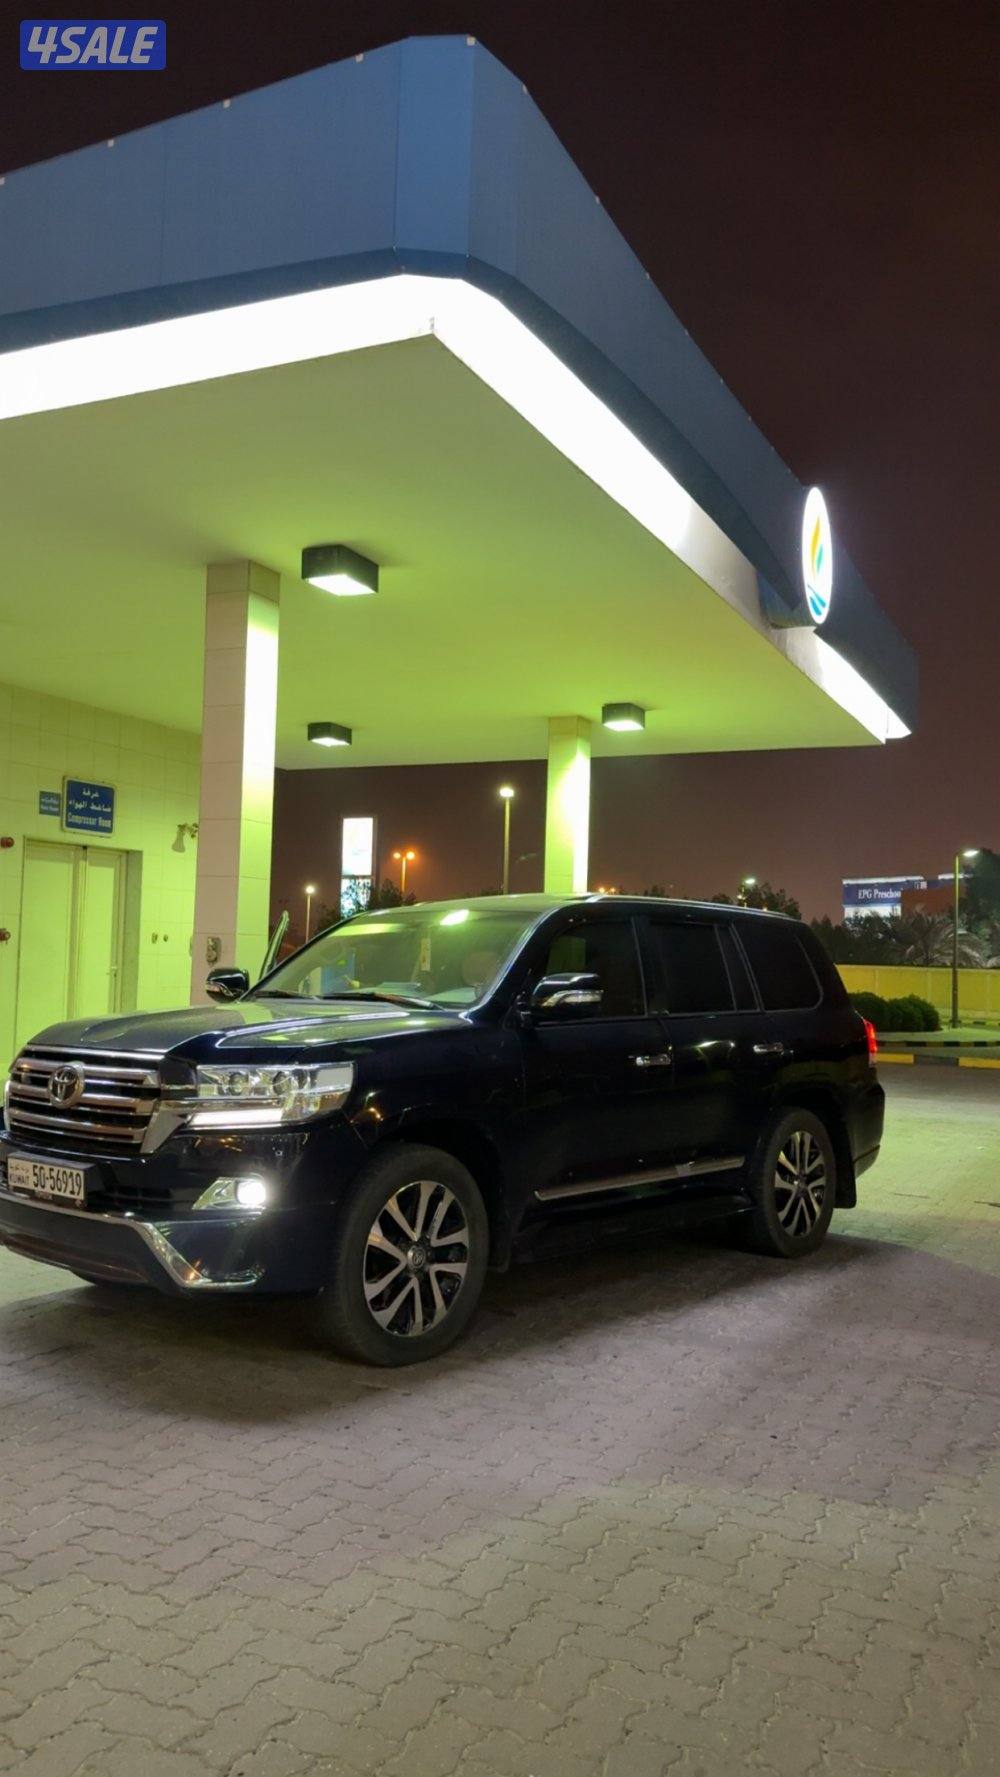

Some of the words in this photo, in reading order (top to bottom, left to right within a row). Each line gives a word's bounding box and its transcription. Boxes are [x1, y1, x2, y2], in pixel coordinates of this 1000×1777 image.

[82, 787, 99, 799] غرفة
[68, 800, 88, 810] الهواء
[90, 802, 111, 812] ضاغط
[68, 812, 97, 826] Compressor
[98, 816, 112, 828] Room
[858, 889, 872, 899] EPG
[873, 888, 902, 899] Preschoo
[33, 1164, 82, 1195] 50-56919
